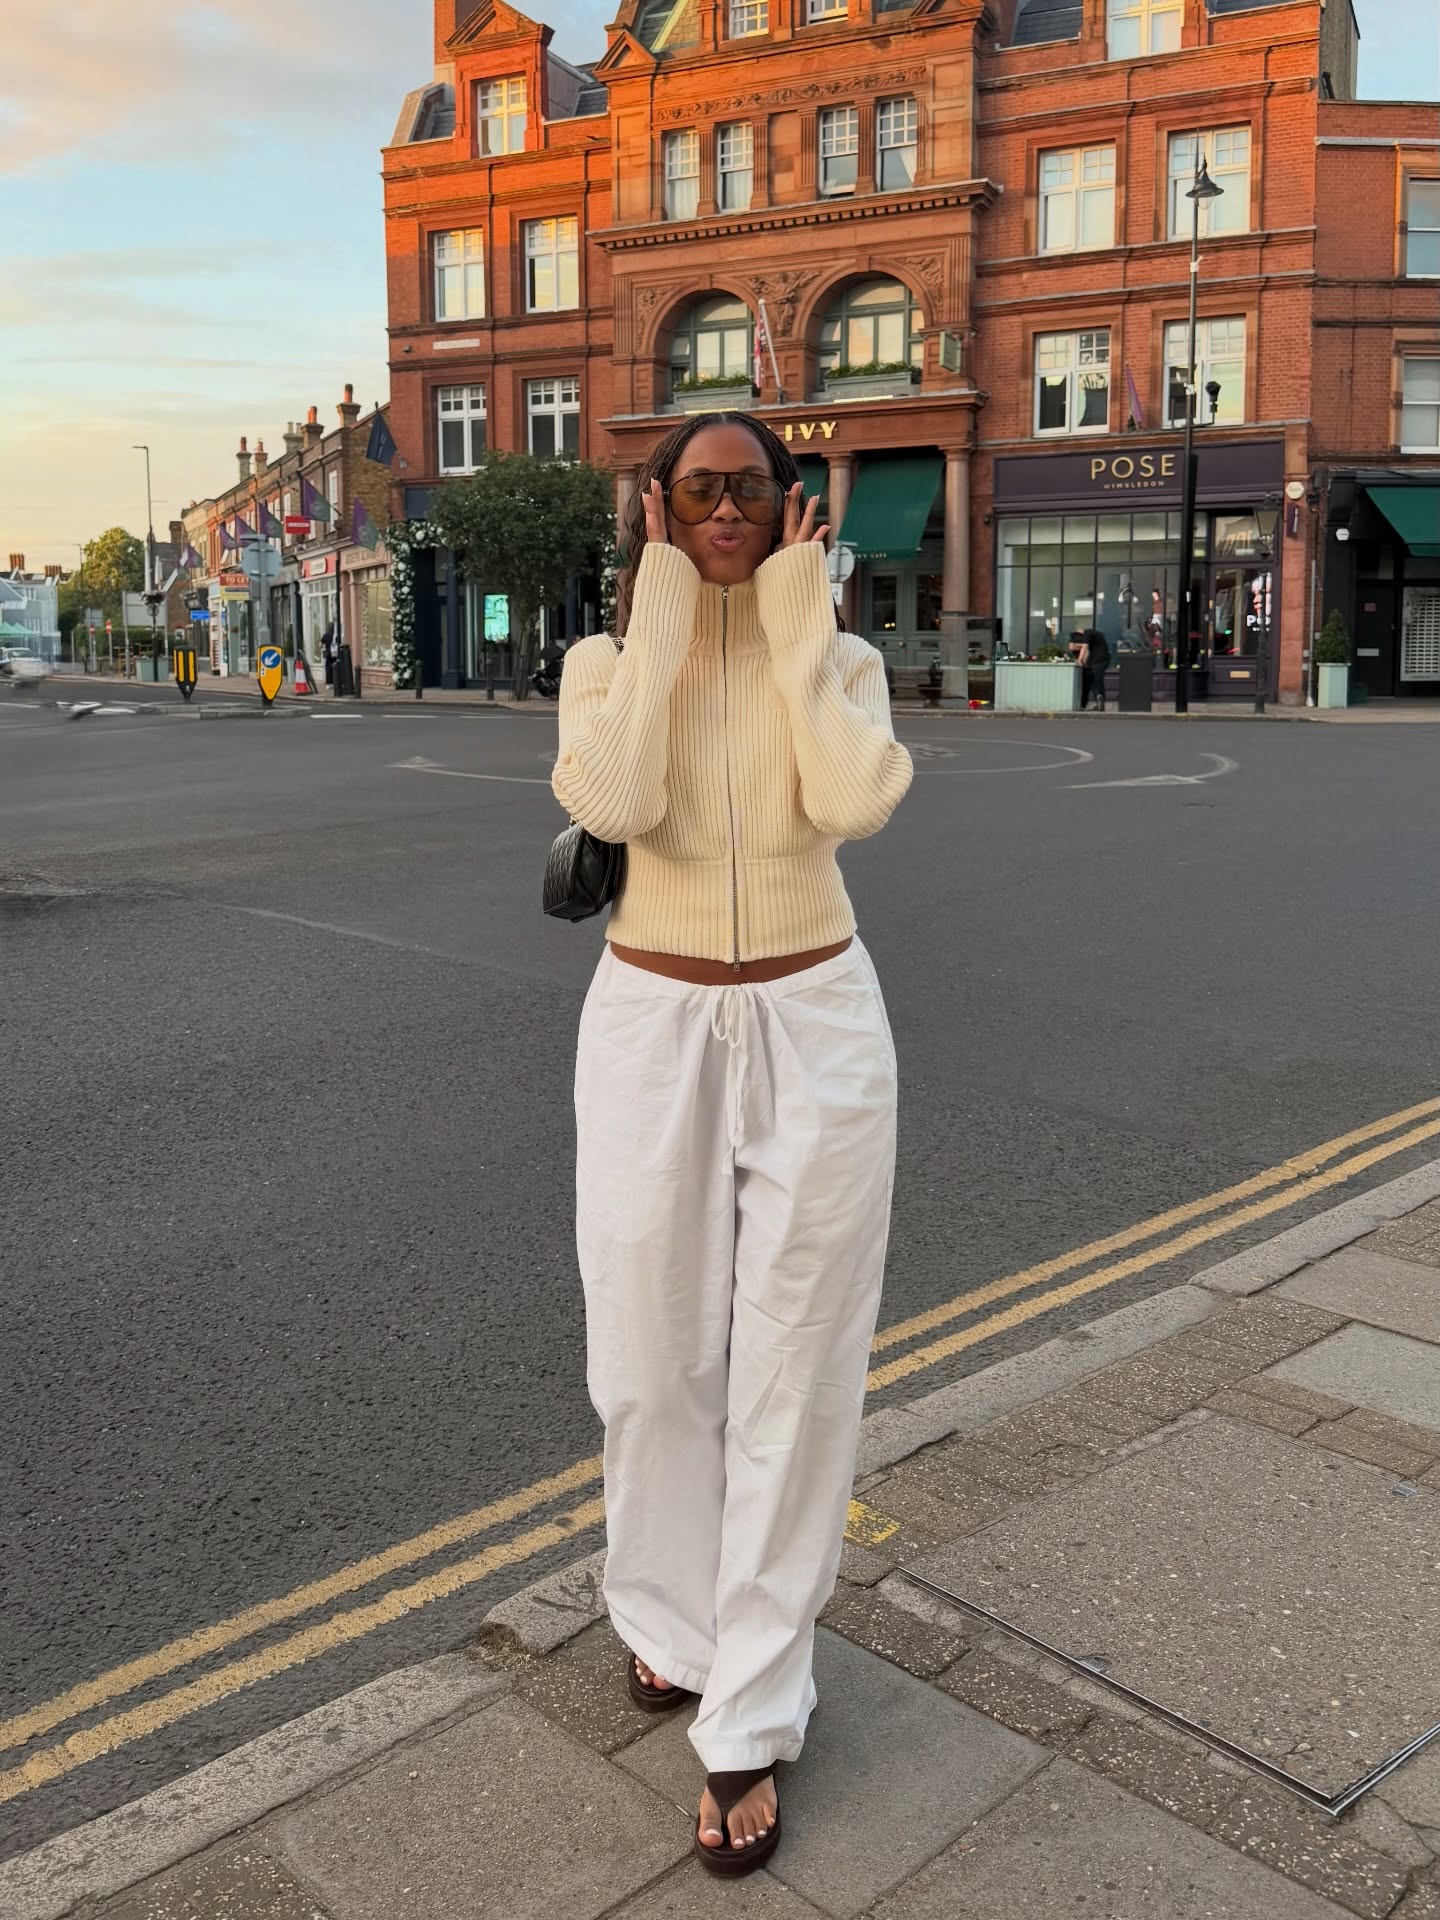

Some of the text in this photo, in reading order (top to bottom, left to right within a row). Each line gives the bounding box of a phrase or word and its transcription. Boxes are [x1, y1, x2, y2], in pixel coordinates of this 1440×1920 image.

[785, 421, 837, 441] IVY
[1090, 453, 1176, 481] POSE
[1103, 480, 1165, 489] WIMBLEDON
